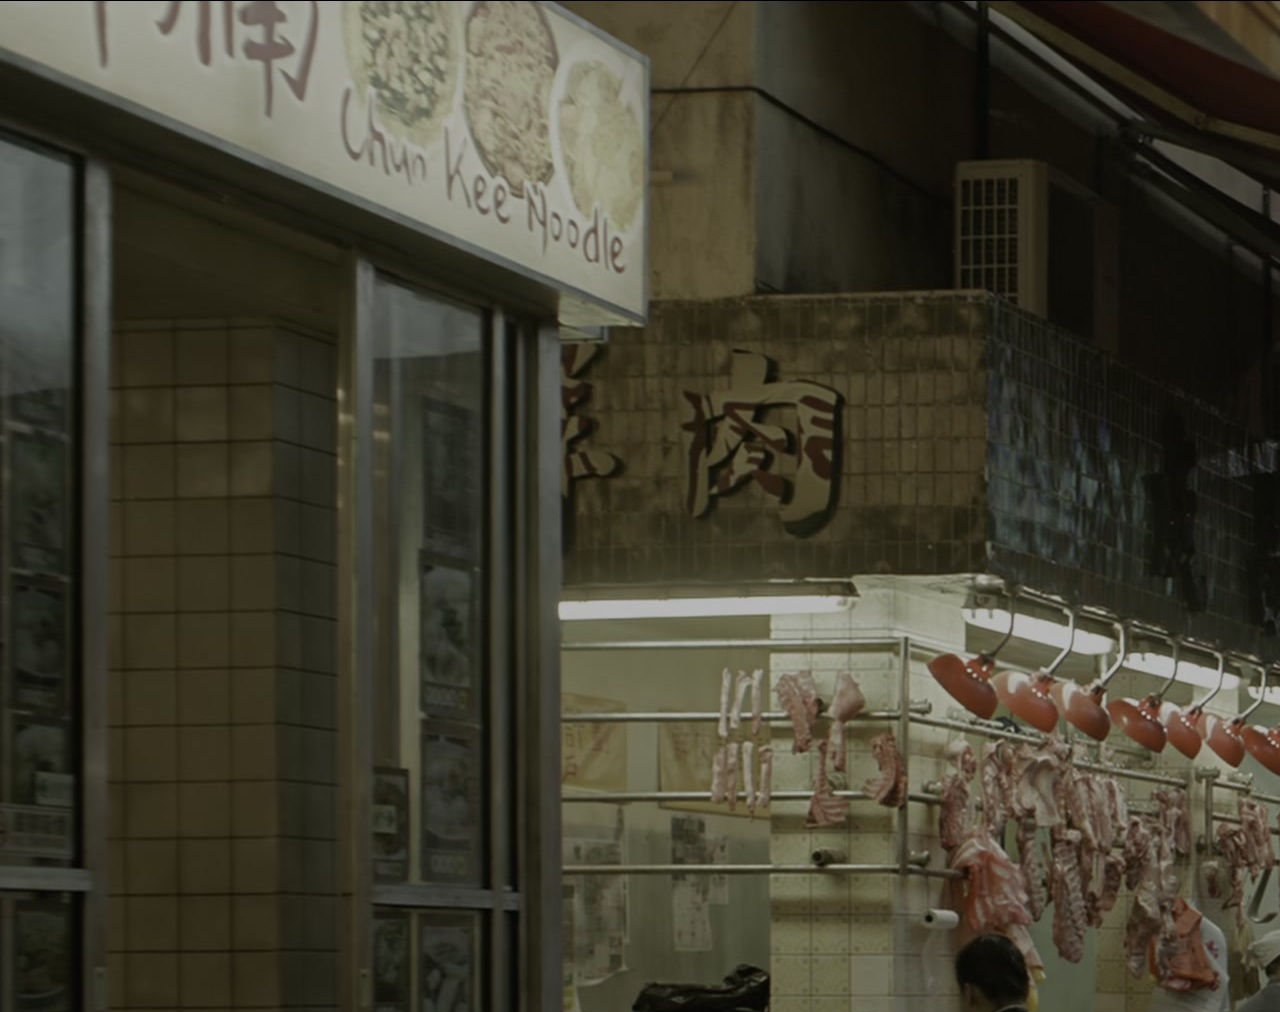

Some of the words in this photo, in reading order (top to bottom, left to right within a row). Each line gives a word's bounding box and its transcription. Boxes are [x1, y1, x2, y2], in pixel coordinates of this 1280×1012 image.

[341, 87, 427, 183] Chun
[442, 127, 511, 225] Kee
[526, 185, 626, 275] Noodle
